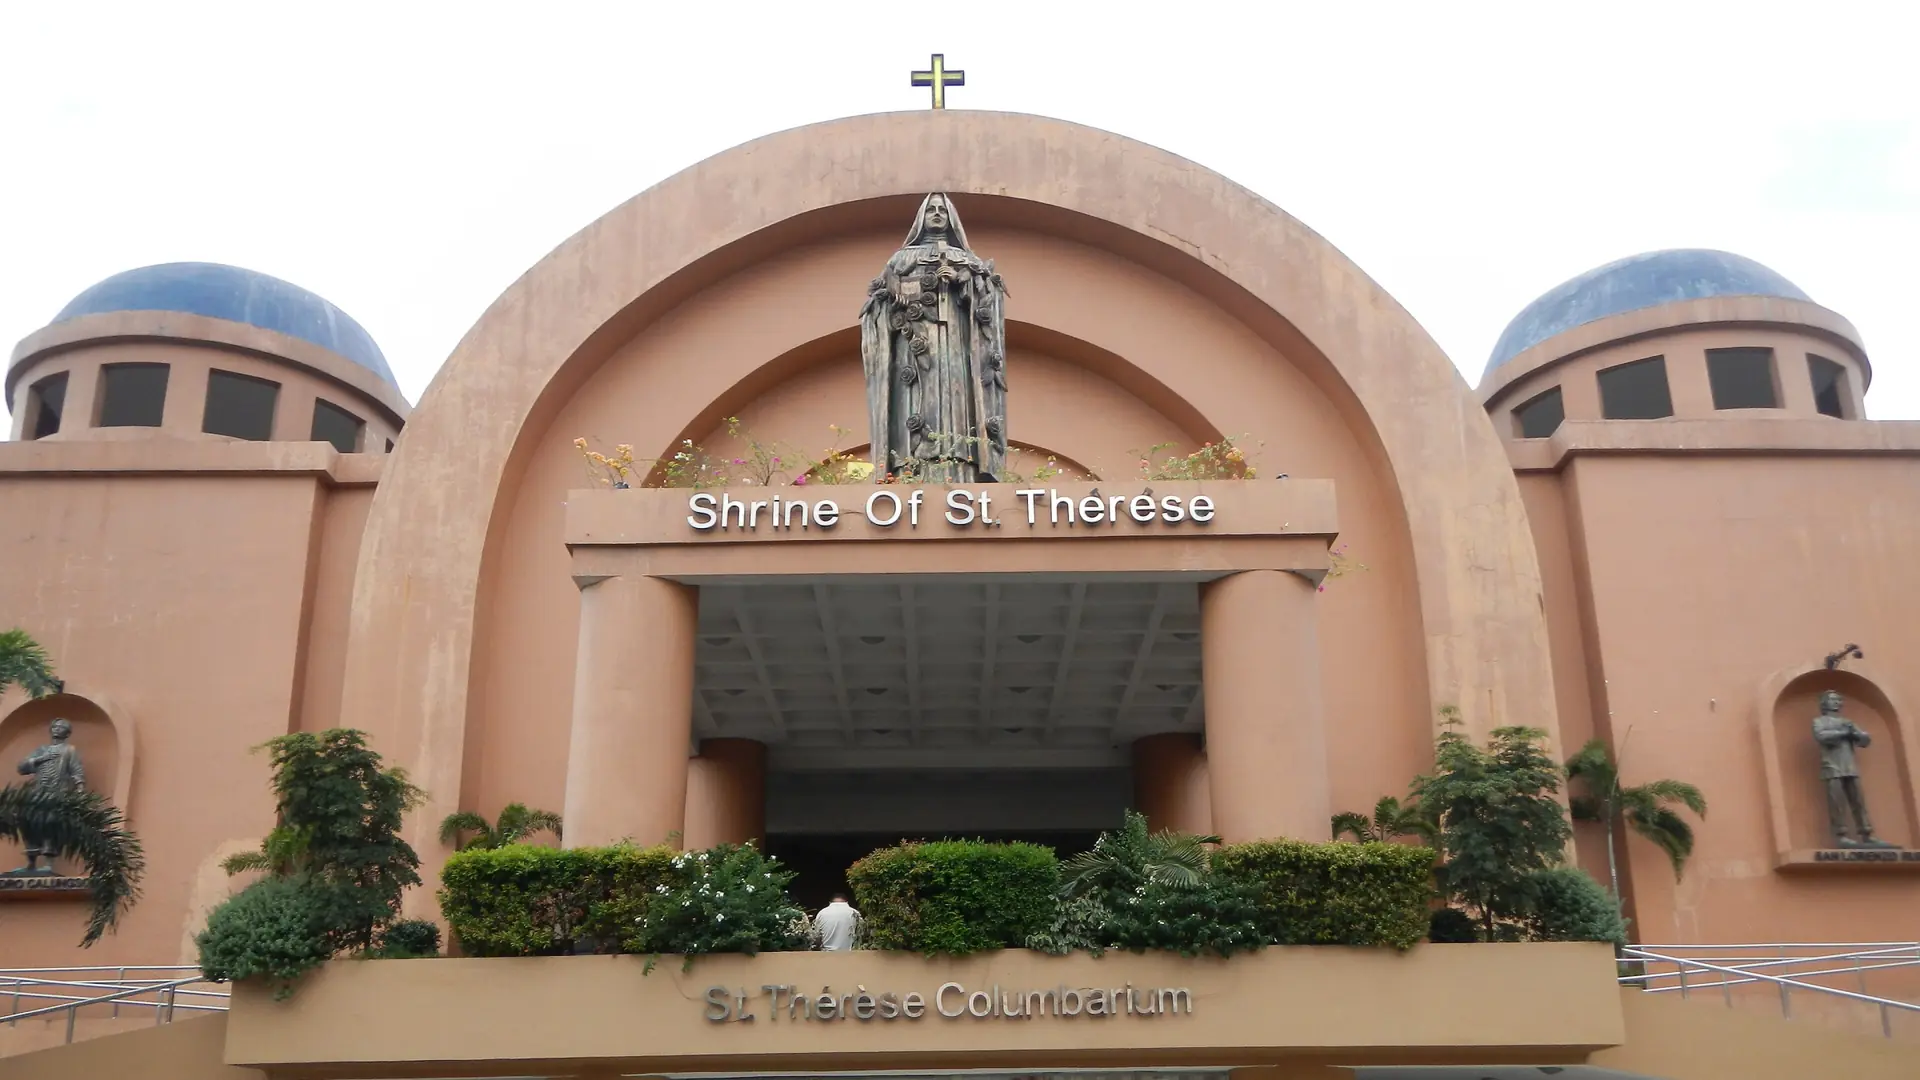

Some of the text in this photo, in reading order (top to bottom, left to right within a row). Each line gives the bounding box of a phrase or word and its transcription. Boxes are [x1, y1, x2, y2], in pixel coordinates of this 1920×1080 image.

[687, 492, 839, 529] Shrine
[864, 489, 924, 528] Of
[935, 981, 1193, 1020] Columbarium
